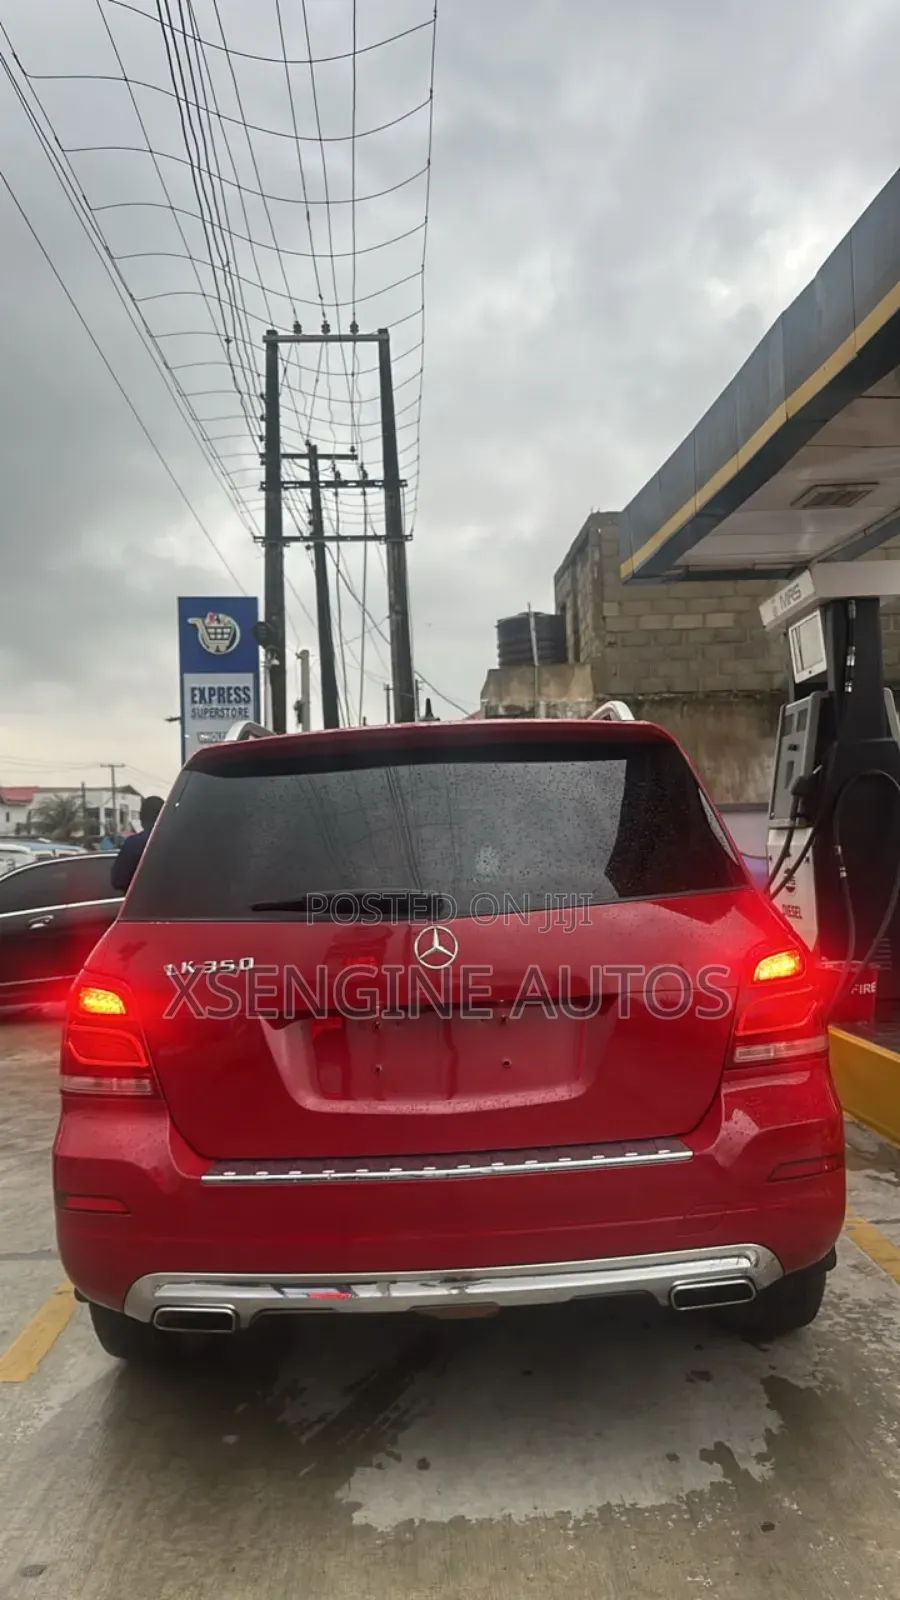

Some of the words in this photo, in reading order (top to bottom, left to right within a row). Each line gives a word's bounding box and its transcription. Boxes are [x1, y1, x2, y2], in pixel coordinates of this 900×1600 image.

[190, 686, 251, 705] EXPRESS
[190, 707, 250, 720] SUPERSTORE
[782, 904, 803, 920] DIESEL
[203, 957, 254, 974] 350
[850, 981, 877, 995] FIRE
